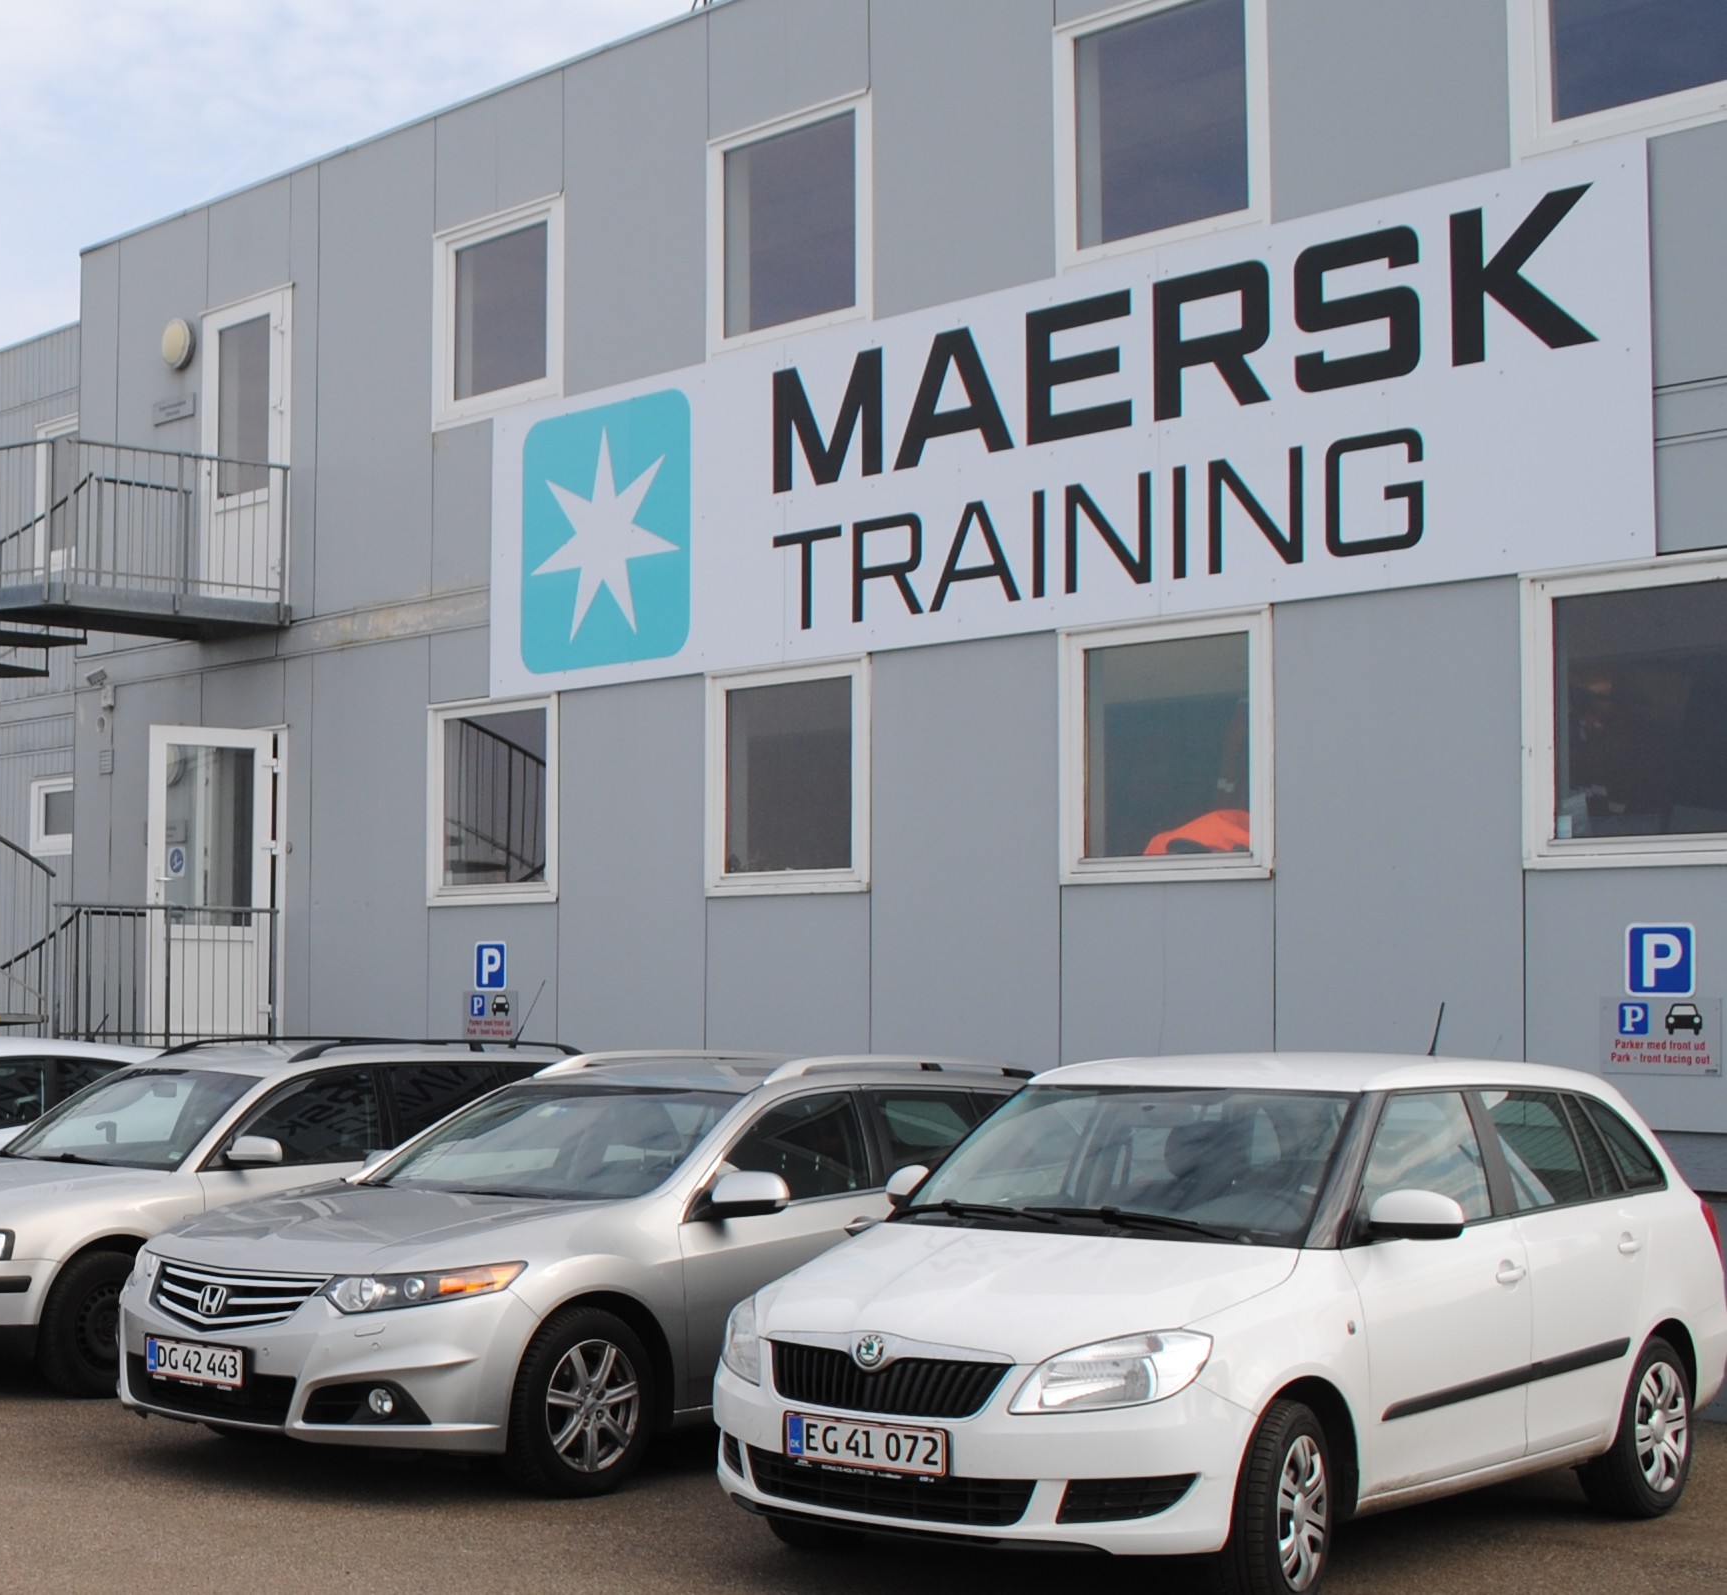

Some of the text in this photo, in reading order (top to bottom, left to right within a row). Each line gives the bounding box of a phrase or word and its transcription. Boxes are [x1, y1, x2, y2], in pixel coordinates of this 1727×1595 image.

[773, 181, 1600, 494] MAERSK
[772, 427, 1425, 630] TRAINING
[482, 948, 501, 985] P
[1642, 933, 1683, 988] P
[473, 996, 483, 1015] P
[1622, 1005, 1645, 1032] P
[1610, 1052, 1630, 1062] Park
[1639, 1053, 1661, 1063] front
[1663, 1053, 1692, 1066] facing
[1695, 1054, 1711, 1065] out
[1614, 1039, 1706, 1051] Parker med front ud
[157, 1345, 238, 1379] DG 42 443
[805, 1422, 839, 1454] EG
[845, 1428, 875, 1459] 41
[885, 1432, 939, 1466] 072
